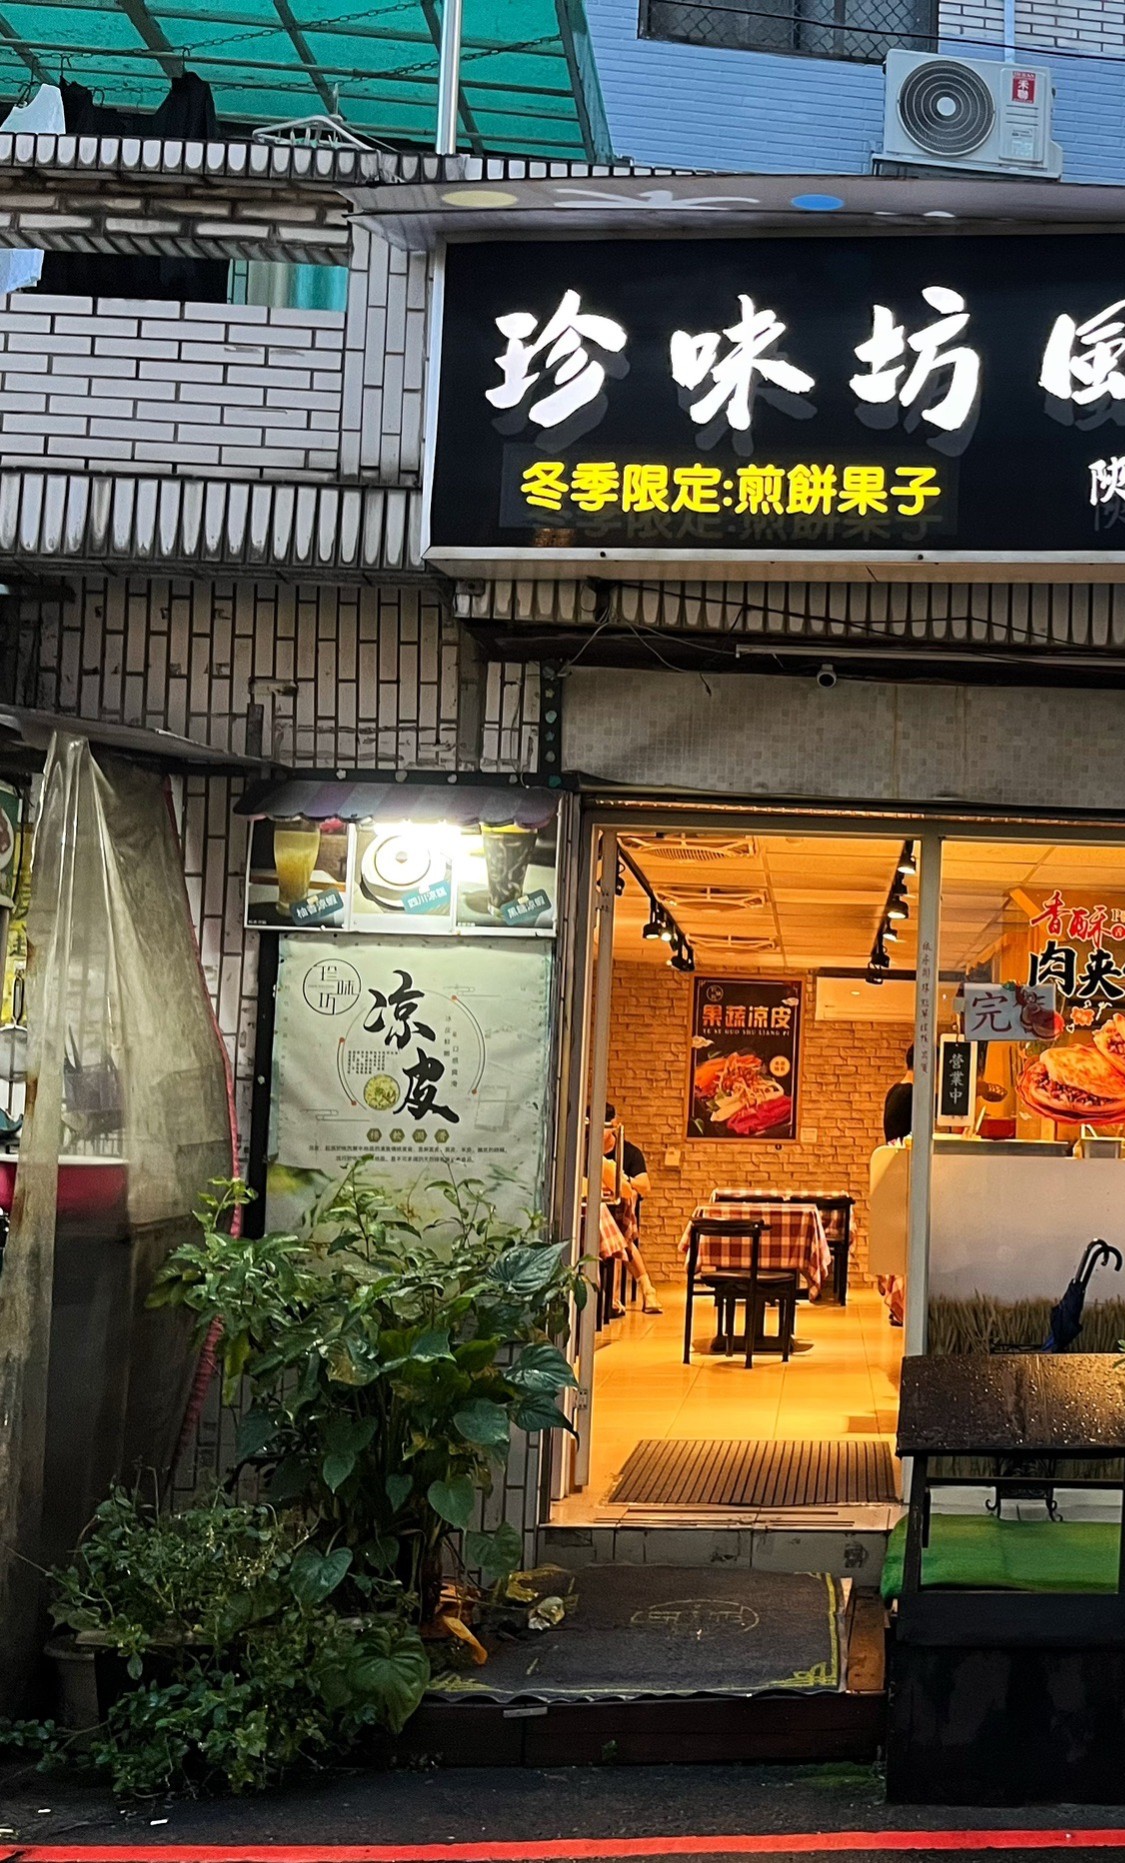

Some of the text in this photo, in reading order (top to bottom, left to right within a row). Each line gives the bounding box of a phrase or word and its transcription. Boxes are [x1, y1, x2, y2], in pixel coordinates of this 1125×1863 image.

[520, 461, 942, 516] 冬季限定:煎餅果子
[1030, 890, 1110, 949] 香酥
[948, 1053, 964, 1105] 營業中
